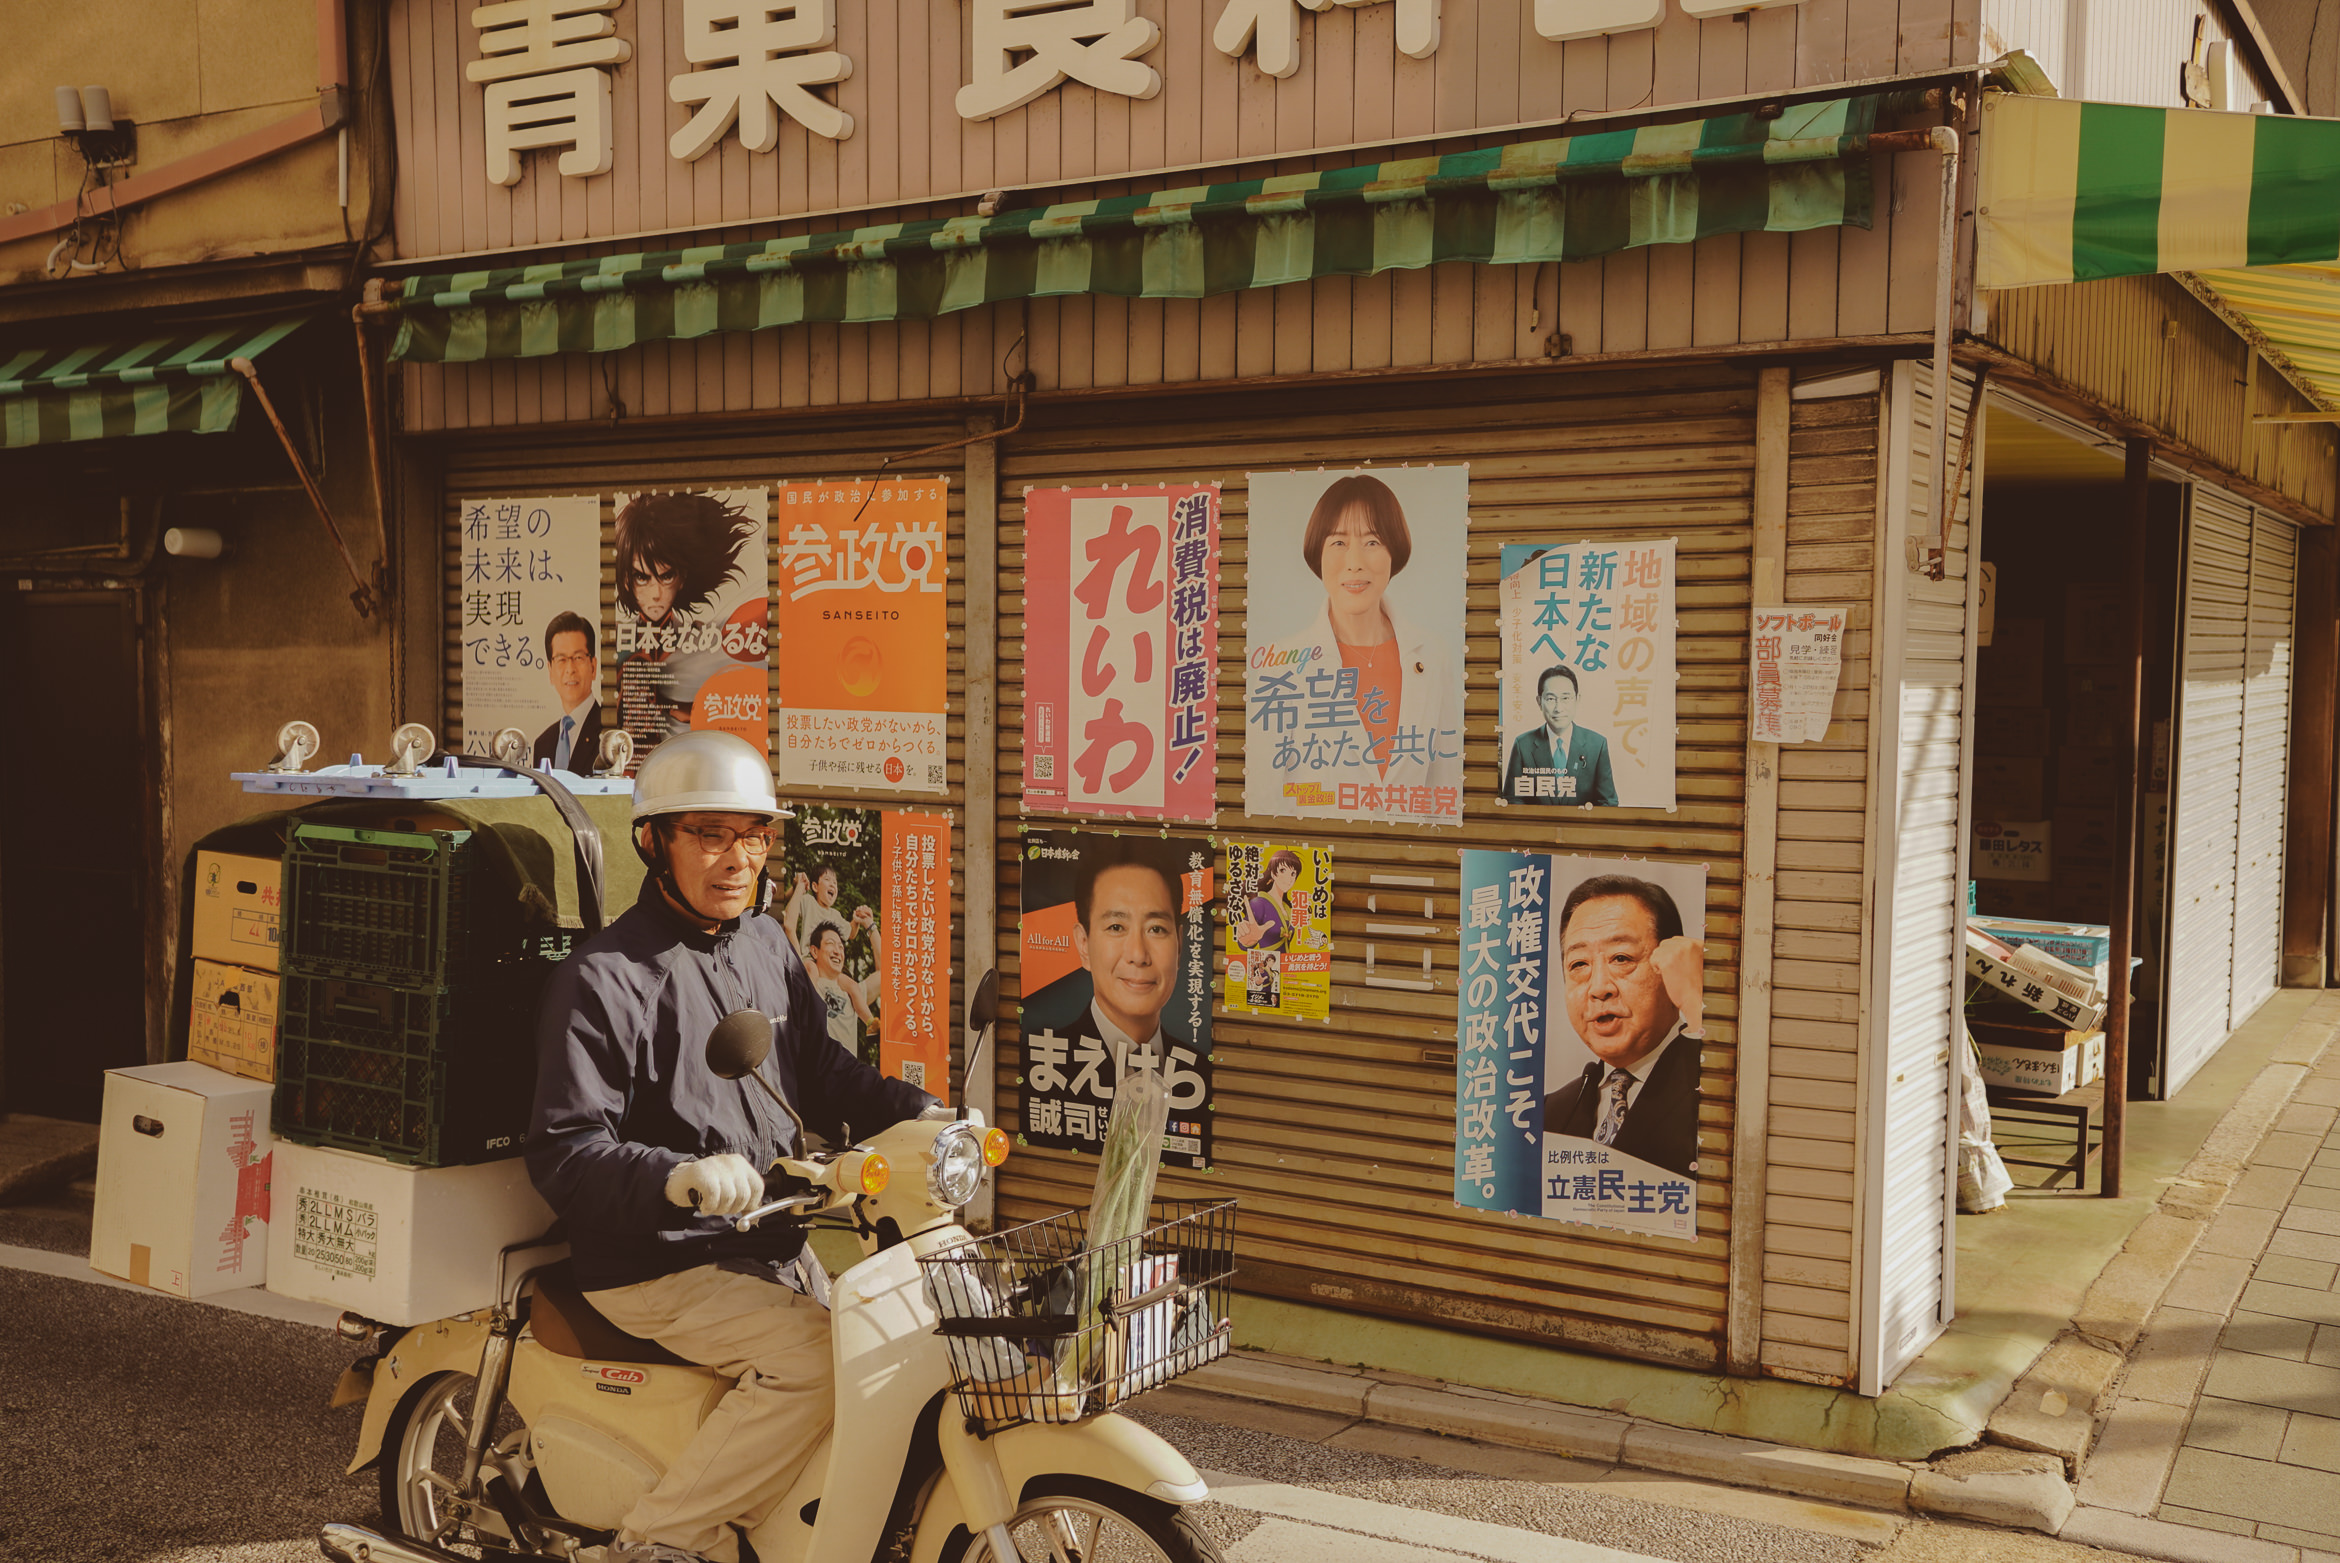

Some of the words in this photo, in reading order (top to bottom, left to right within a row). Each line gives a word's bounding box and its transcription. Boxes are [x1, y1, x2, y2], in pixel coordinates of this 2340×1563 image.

[786, 487, 943, 505] 国民が政治に参加する。
[465, 503, 551, 541] 希望の
[465, 546, 564, 584] 未来は、
[781, 521, 943, 602] 参政党
[465, 589, 523, 626] 実現
[822, 610, 900, 621] SANSEITO
[1529, 552, 1571, 661] 日本へ
[1573, 550, 1618, 672] 新たな
[1756, 613, 1843, 632] ソフトボール
[465, 632, 545, 670] できる。
[616, 621, 768, 655] 日本をなめるな
[1073, 504, 1165, 795] れいわ
[1511, 607, 1523, 665] 少子化対策
[1789, 644, 1838, 656] 見学・練習
[1814, 633, 1837, 643] 同好会
[1250, 644, 1323, 675] Change
[1612, 548, 1662, 769] 地域の声で、
[1250, 667, 1390, 733] 希望を
[1511, 672, 1523, 723] 安全・安心
[1755, 635, 1783, 738] 部員募集
[703, 692, 762, 722] 参政党
[786, 714, 942, 736] 投票したい政党がないから、
[787, 733, 941, 756] 自分たちでゼロからつくる。
[1272, 724, 1458, 772] あなたと共に
[1514, 776, 1577, 798] 自民党
[1522, 767, 1568, 775] 政治は国民のもの
[1298, 792, 1334, 805] 裏金政治
[1338, 782, 1458, 816] 日本共産党
[801, 816, 862, 848] 参政党
[1244, 845, 1260, 893] 絶対に
[1313, 849, 1330, 919] いじめは
[267, 926, 279, 943] 10
[904, 833, 919, 1039] 自分たちでゼロからつくる。
[920, 833, 936, 1040] 投票したい政党がないから、
[1027, 933, 1042, 945] All
[1042, 935, 1054, 946] for
[1054, 935, 1070, 947] All
[1966, 950, 2044, 1004] 新れん
[1503, 863, 1546, 1145] 政権交代こそ、
[1461, 883, 1504, 1200] 最大の政治改革。
[1028, 1027, 1206, 1111] まえはら
[2011, 1057, 2060, 1074] ほんまもん
[1029, 1096, 1097, 1141] 誠司
[486, 1136, 511, 1150] IFCO
[1547, 1149, 1610, 1165] 比例代表は
[1546, 1168, 1690, 1215] 立憲民主党
[298, 1197, 308, 1212] 秀
[310, 1200, 322, 1215] 2L
[325, 1203, 332, 1217] L
[334, 1206, 343, 1219] M
[346, 1208, 354, 1222] S
[357, 1212, 375, 1227] バラ
[309, 1215, 321, 1229] 2L
[324, 1218, 331, 1232] L
[333, 1220, 343, 1234] M
[355, 1228, 376, 1241] 小パック
[298, 1226, 315, 1243] 特大
[317, 1231, 335, 1248] 秀大
[336, 1235, 354, 1252] 無大
[307, 1247, 315, 1256] 20
[316, 1248, 325, 1260] 25
[325, 1251, 334, 1263] 30
[334, 1254, 344, 1265] 50
[938, 1234, 968, 1248] HONDA
[582, 1366, 600, 1375] Super
[605, 1369, 639, 1382] Cub
[597, 1383, 630, 1394] HONDA
